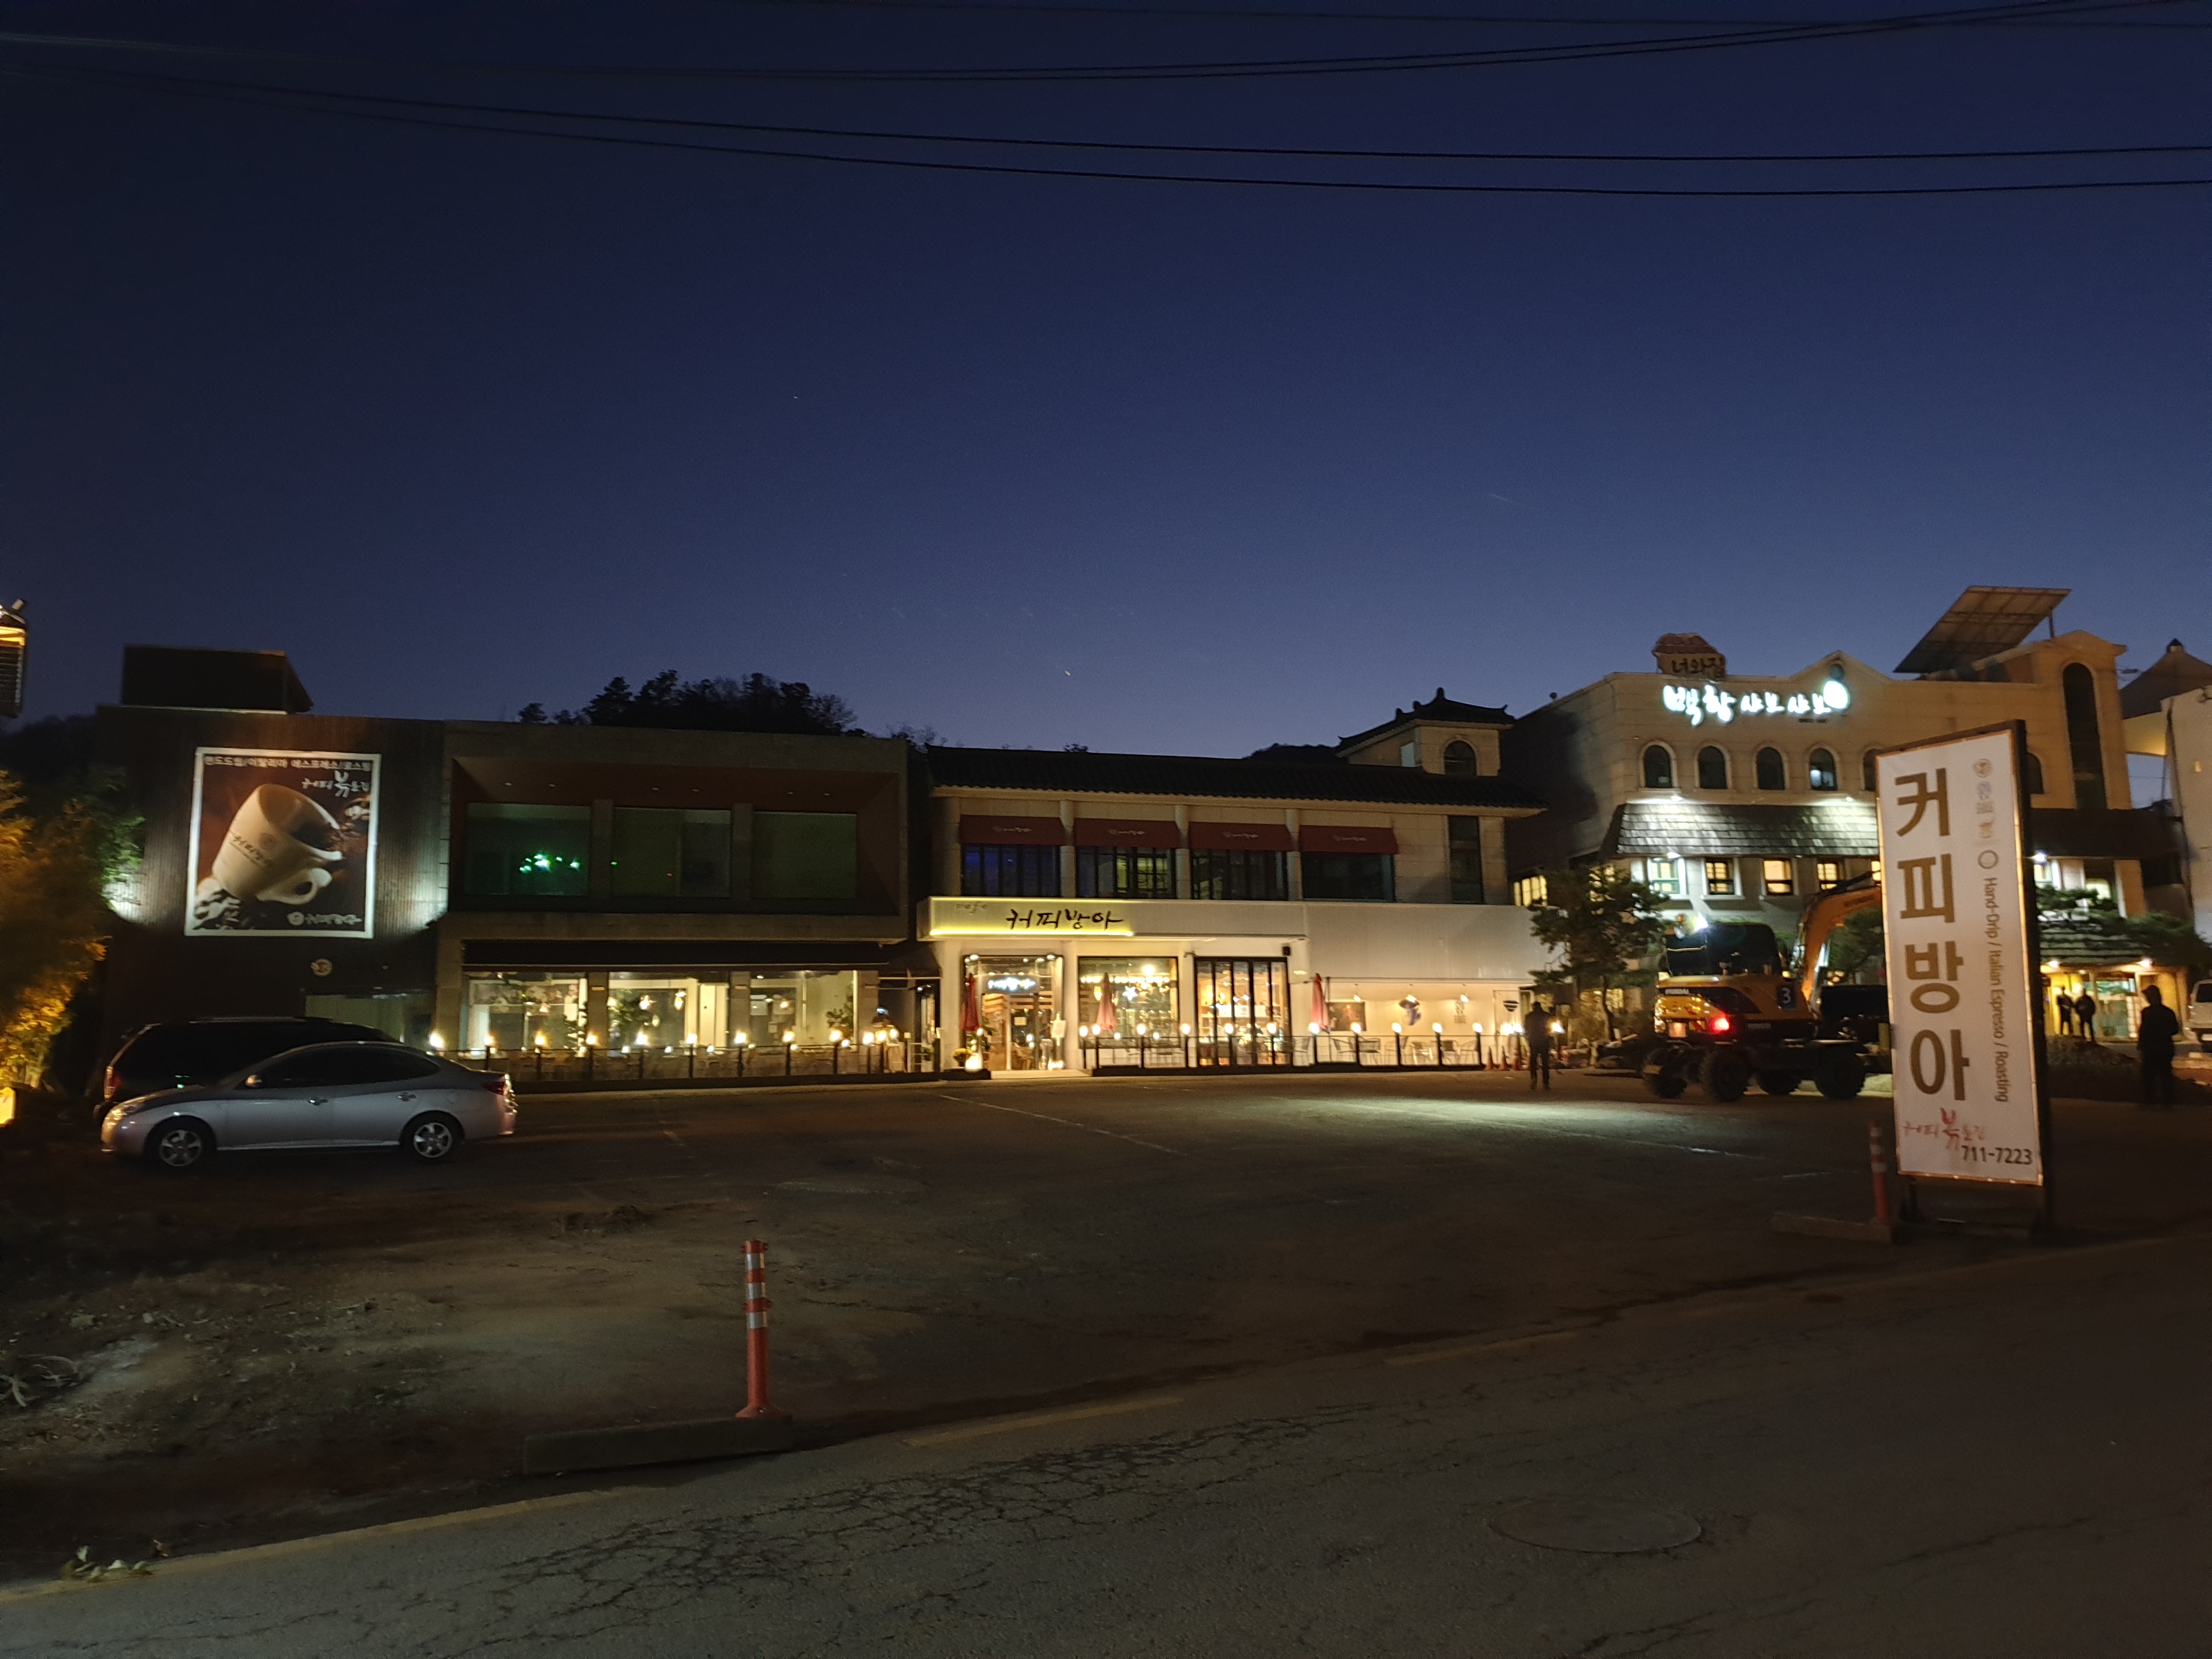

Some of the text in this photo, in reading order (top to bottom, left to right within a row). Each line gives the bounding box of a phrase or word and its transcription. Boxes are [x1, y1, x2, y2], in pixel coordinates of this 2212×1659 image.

[1006, 908, 1124, 930] 커피방아
[1983, 877, 2000, 939] Hand-Drip
[1894, 768, 1971, 1101] 커피방아
[1989, 950, 2004, 986] Italian
[1782, 986, 1791, 1005] 3
[1990, 989, 2006, 1039] Espresso
[1994, 1051, 2011, 1103] Roasting
[1961, 1144, 2033, 1165] 711-7223
